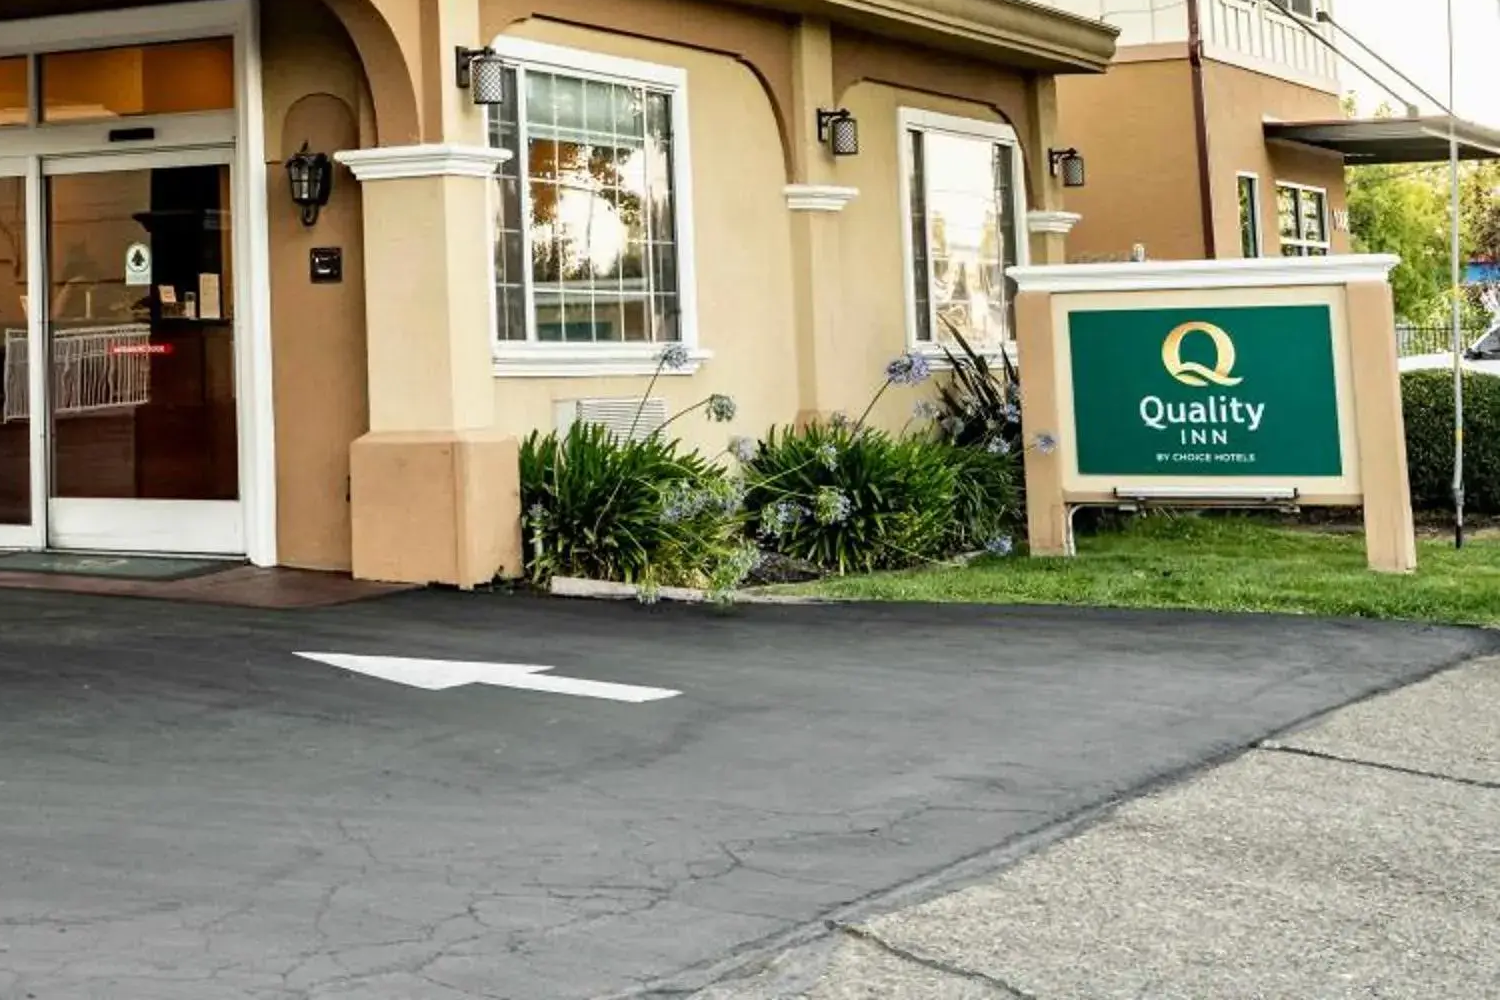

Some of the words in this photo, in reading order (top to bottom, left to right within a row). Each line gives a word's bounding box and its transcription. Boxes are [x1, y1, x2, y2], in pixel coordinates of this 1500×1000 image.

[1161, 321, 1244, 387] Q
[1139, 395, 1265, 431] Quality
[1181, 429, 1227, 445] INN
[1156, 453, 1170, 462] BY
[1172, 453, 1211, 462] CHOICE
[1214, 453, 1256, 462] HOTELS
